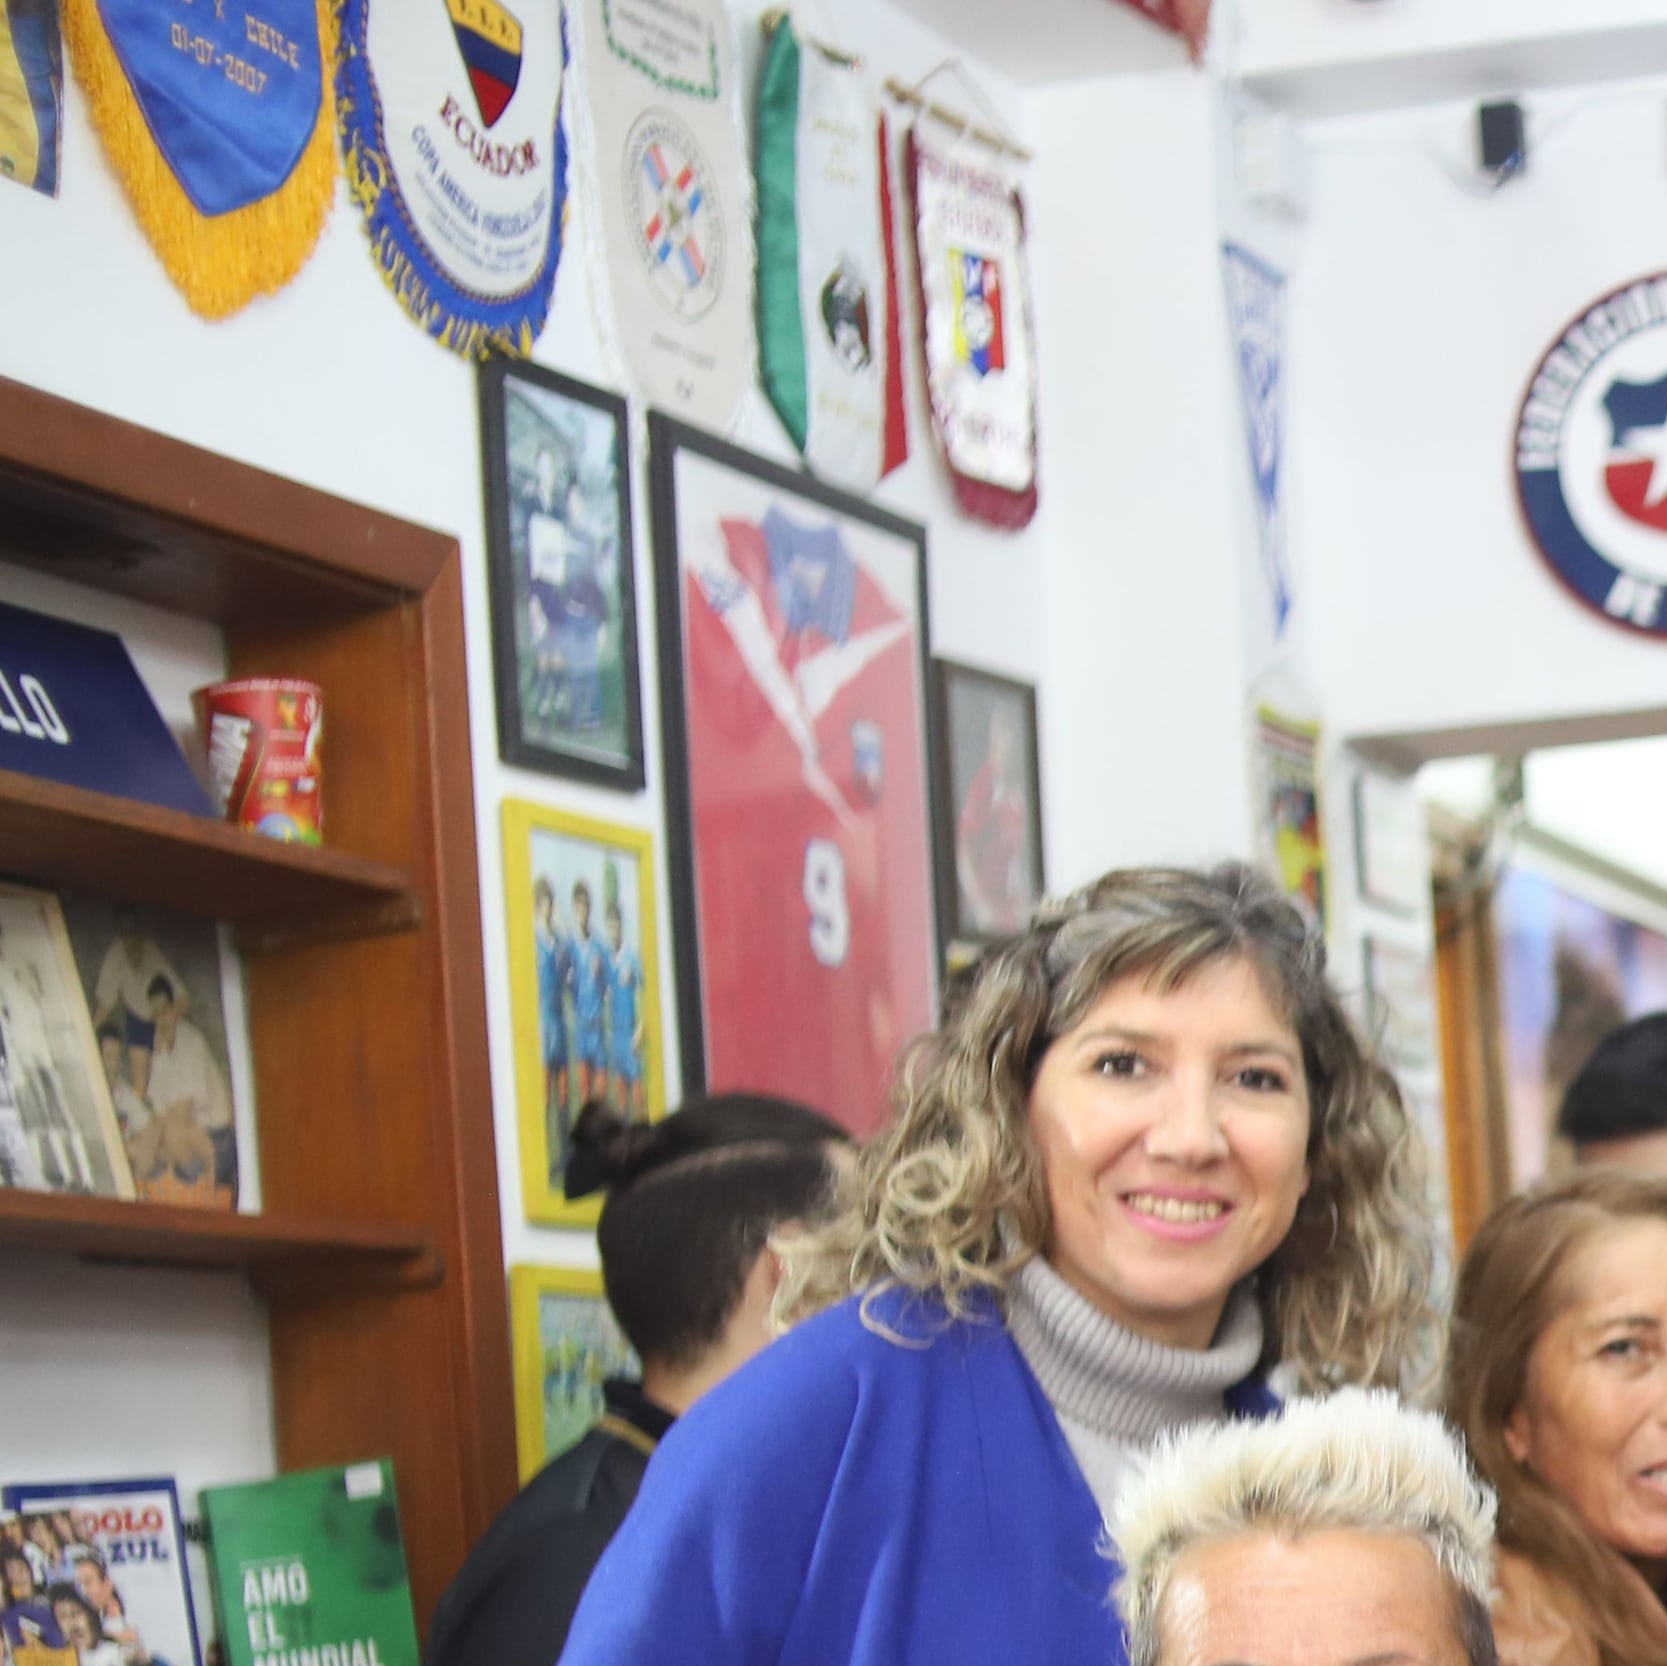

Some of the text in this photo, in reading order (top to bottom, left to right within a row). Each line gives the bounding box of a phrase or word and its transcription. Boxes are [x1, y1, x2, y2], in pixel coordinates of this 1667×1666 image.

[170, 22, 268, 95] 01-07-2007
[245, 14, 300, 70] CHILE
[440, 92, 540, 176] ECUADOR
[803, 837, 851, 968] 9
[244, 1561, 309, 1611] AMO
[248, 1612, 286, 1651] EL
